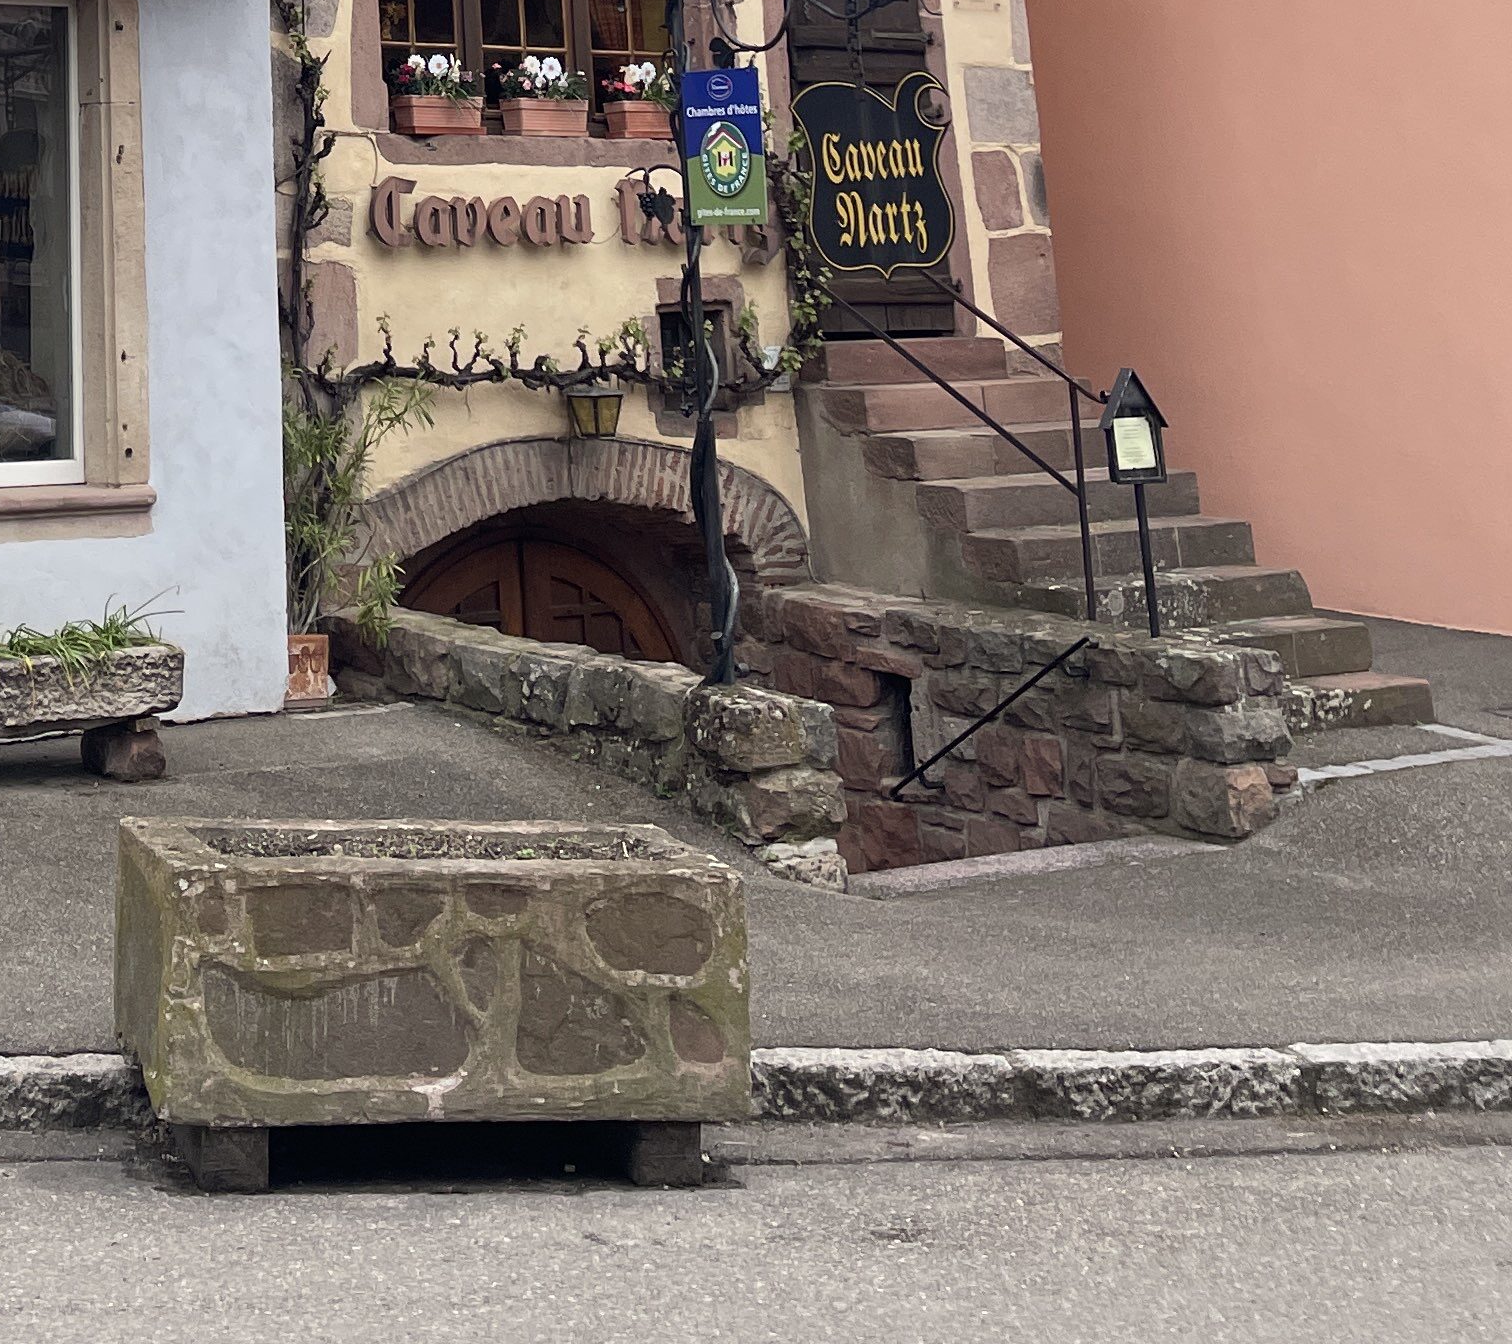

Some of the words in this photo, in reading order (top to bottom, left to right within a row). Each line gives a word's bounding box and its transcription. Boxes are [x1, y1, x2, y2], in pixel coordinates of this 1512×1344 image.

[686, 105, 726, 118] Chambres
[727, 103, 758, 116] d'hôtes
[717, 183, 728, 194] DE
[730, 152, 748, 192] FRANCE
[821, 132, 925, 185] Caveau
[368, 175, 596, 248] Caveau
[835, 190, 928, 254] Nartz
